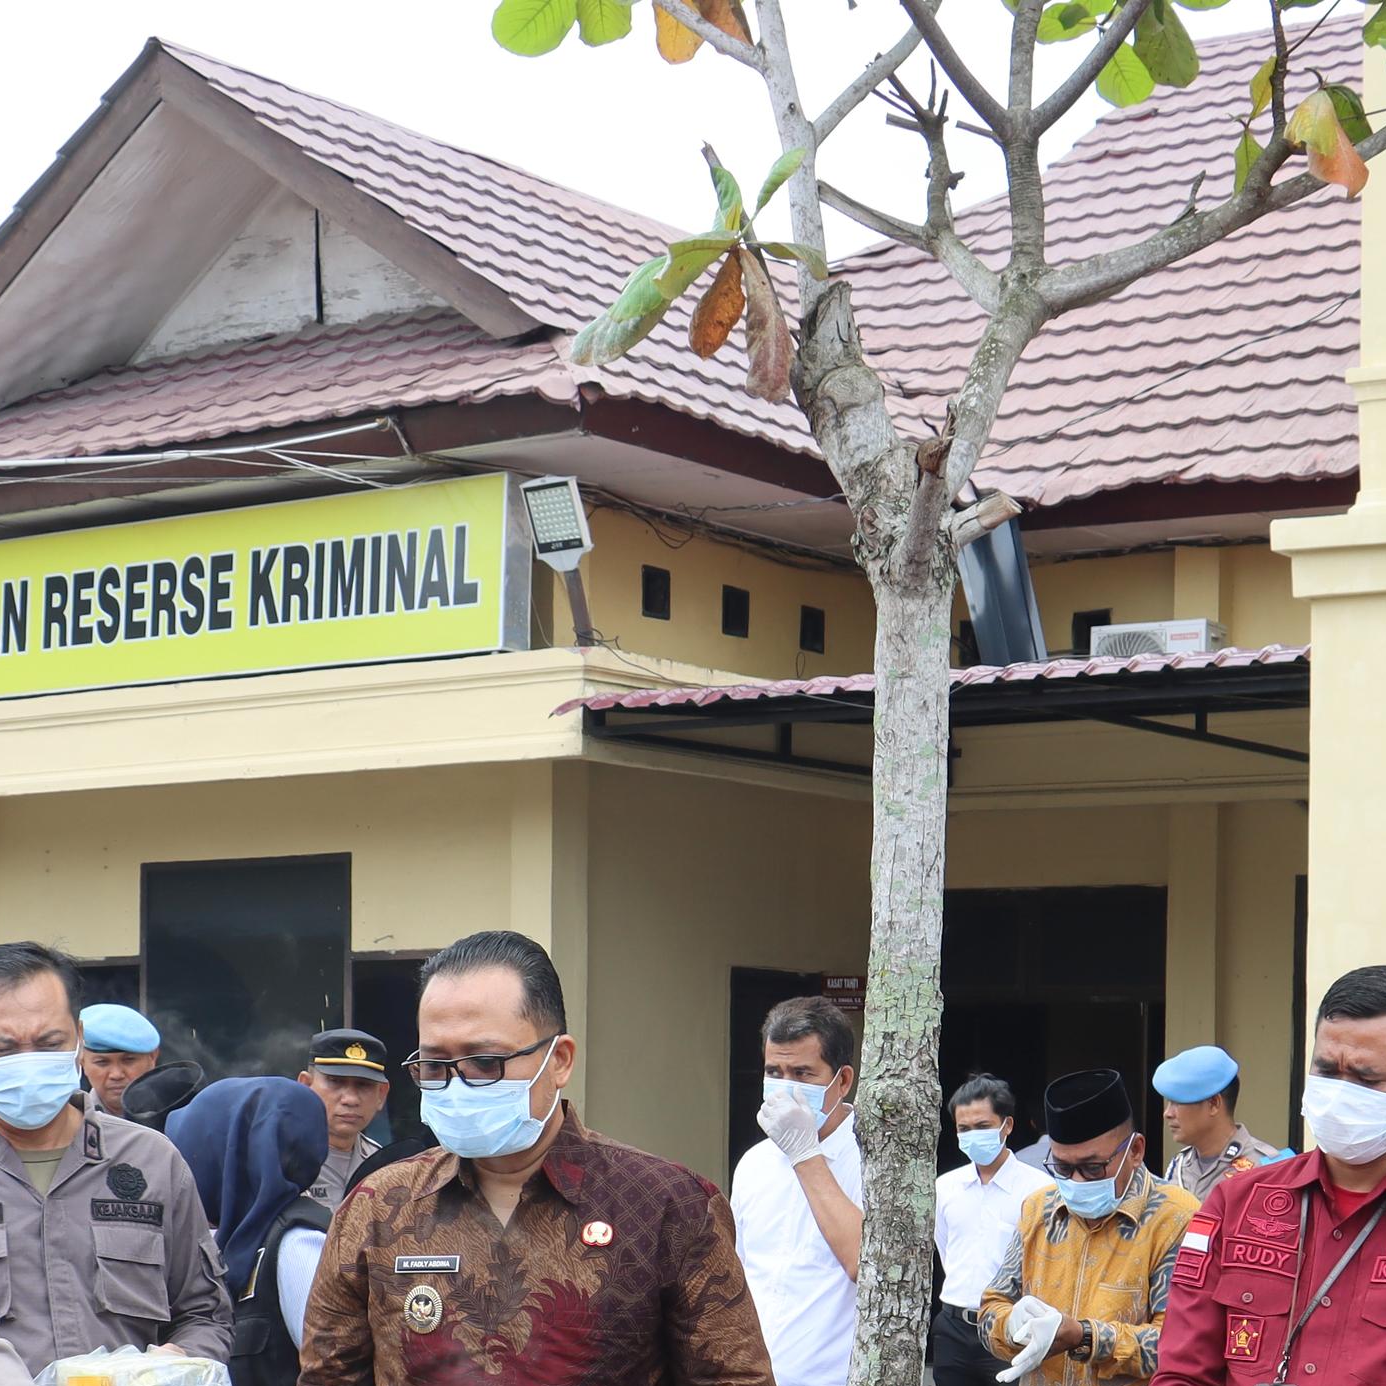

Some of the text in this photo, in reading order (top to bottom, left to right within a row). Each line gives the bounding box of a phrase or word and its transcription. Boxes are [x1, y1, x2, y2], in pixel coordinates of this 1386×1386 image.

[42, 552, 234, 649] RESERSE
[248, 524, 480, 627] KRIMINAL
[1232, 1244, 1290, 1269] RUDY
